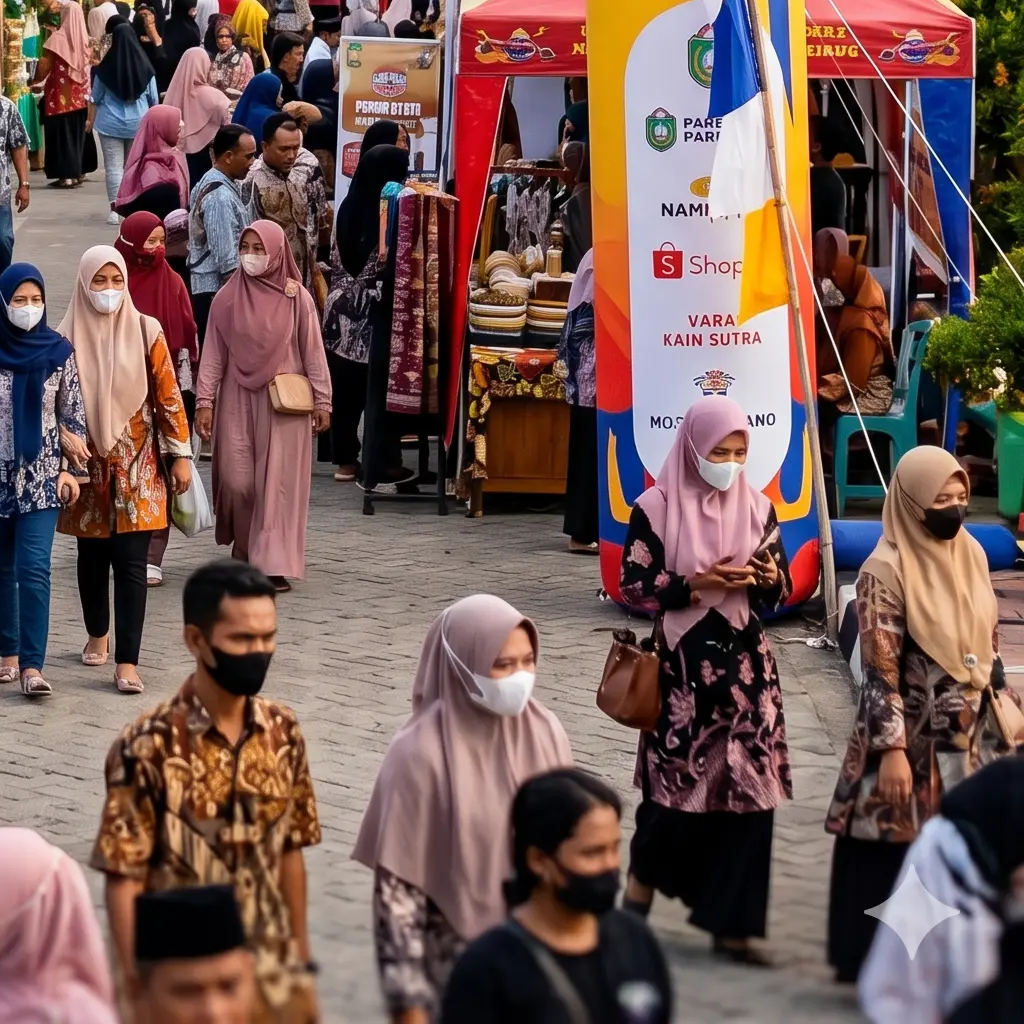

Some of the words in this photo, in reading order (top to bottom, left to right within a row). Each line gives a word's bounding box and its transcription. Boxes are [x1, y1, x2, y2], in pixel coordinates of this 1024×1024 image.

[807, 44, 859, 57] EIRUG
[684, 118, 722, 129] PARE
[684, 131, 720, 143] PAR
[689, 255, 742, 279] Shop
[688, 314, 737, 327] VARA
[663, 333, 703, 347] KAIN
[709, 331, 762, 347] SUTRA
